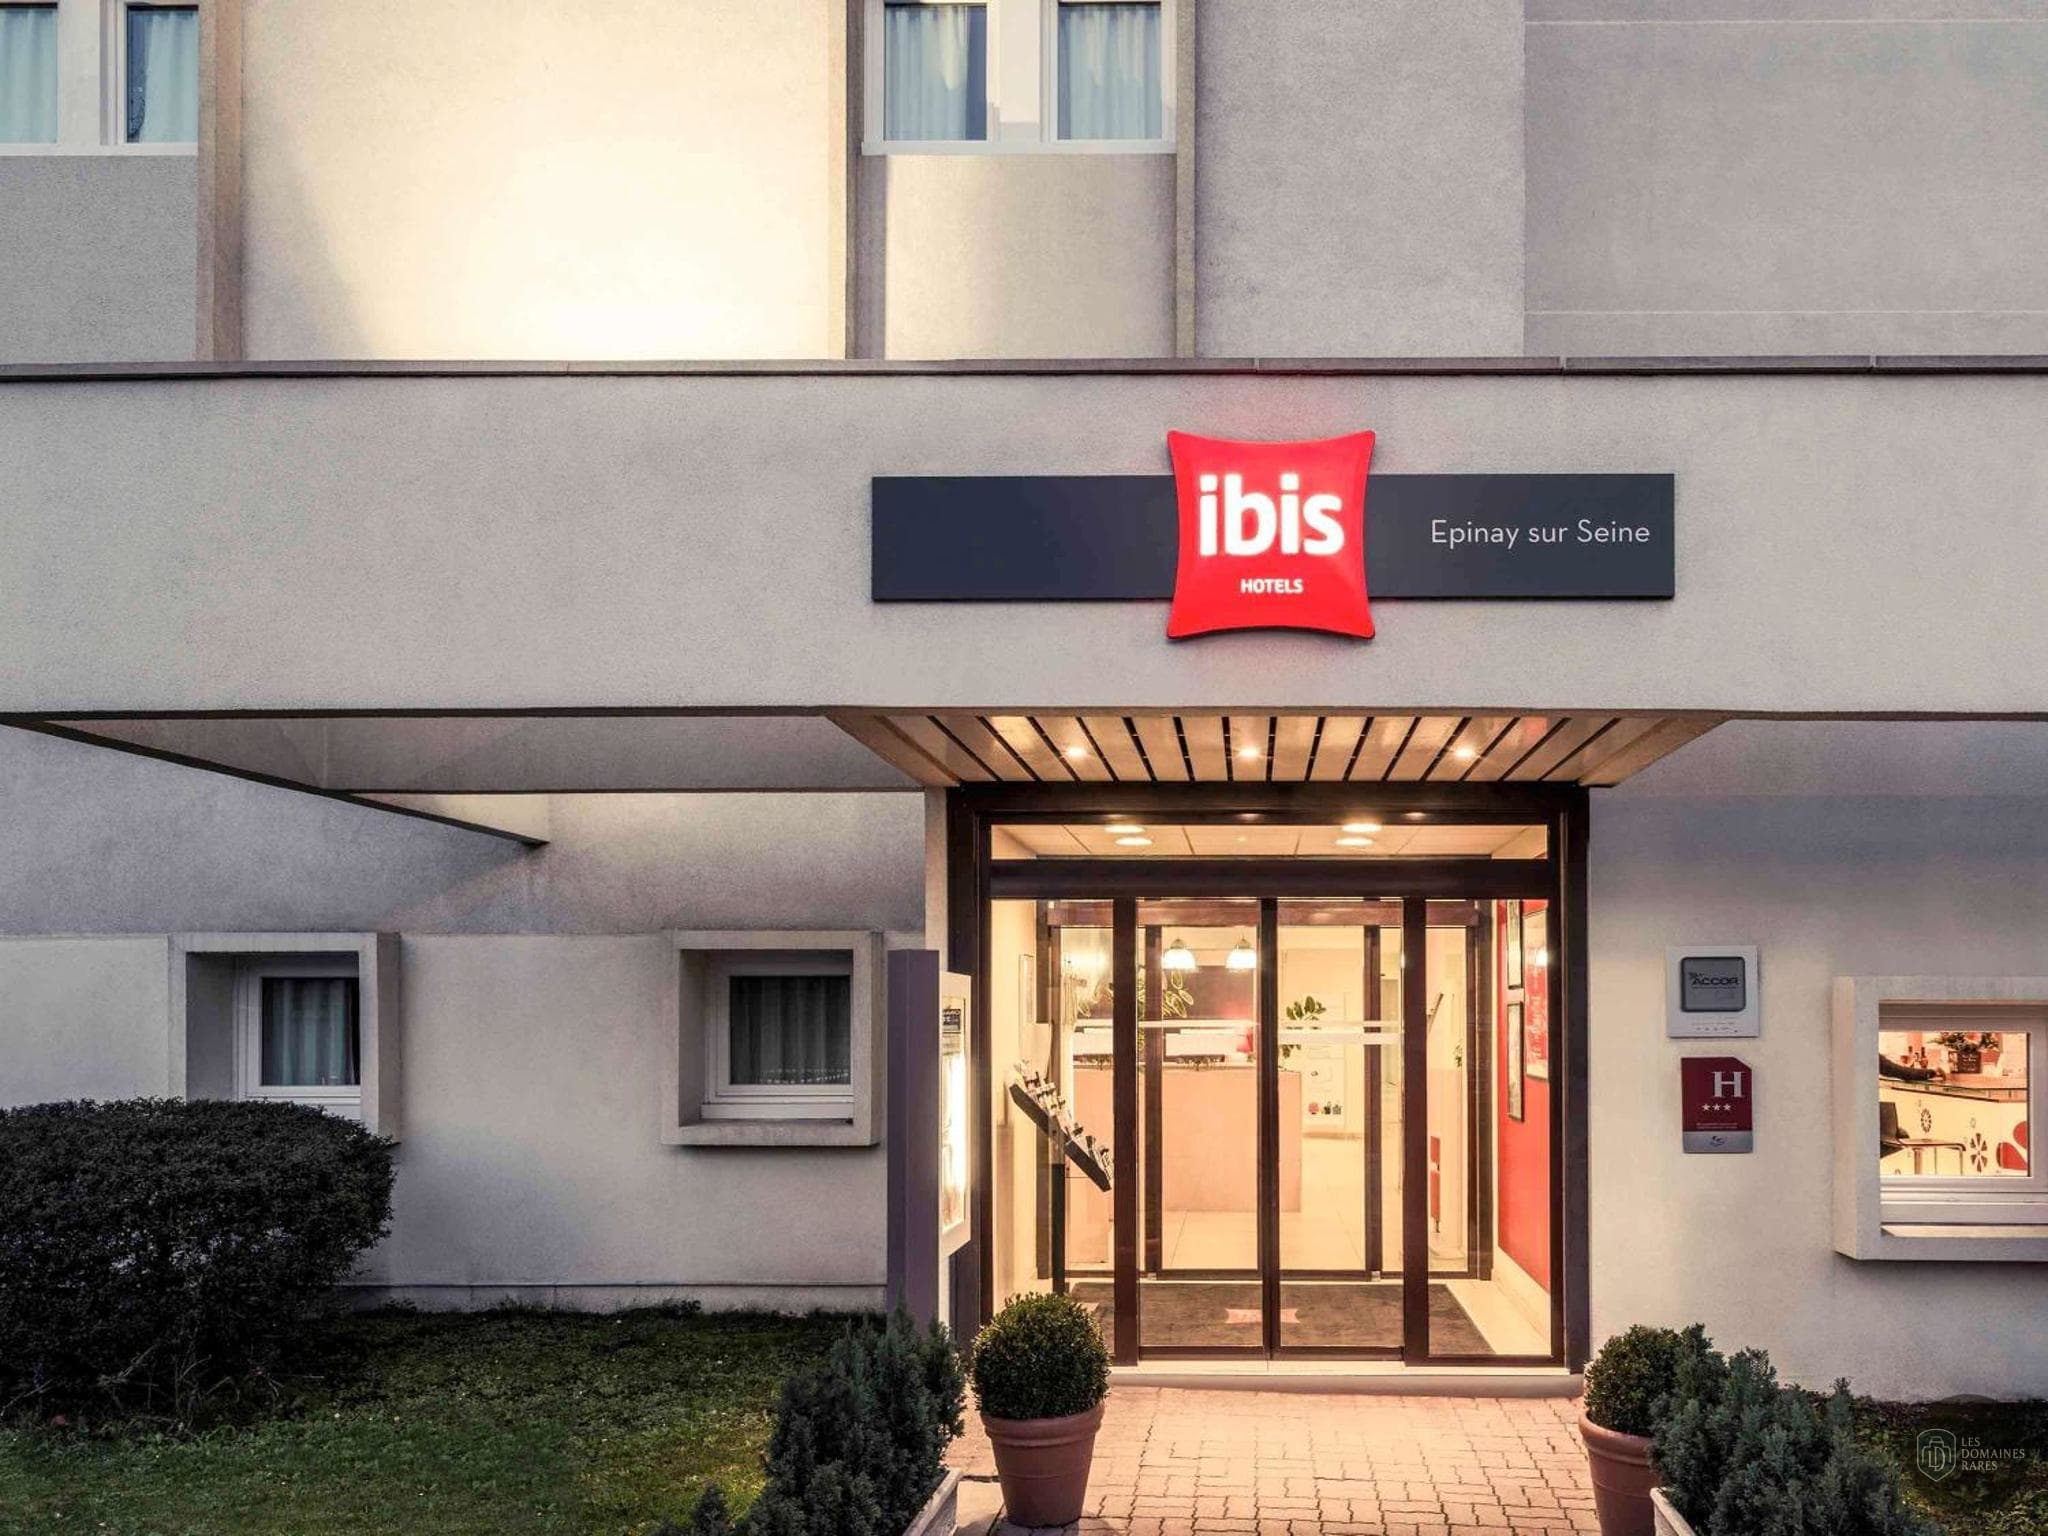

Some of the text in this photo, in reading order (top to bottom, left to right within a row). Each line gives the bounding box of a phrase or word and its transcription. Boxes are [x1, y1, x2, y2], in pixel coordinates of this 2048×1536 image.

[1199, 473, 1345, 556] ibis
[1431, 519, 1650, 550] Epinay sur Seine
[1240, 578, 1304, 594] HOTELS
[1691, 976, 1740, 986] ACCOR
[1712, 1071, 1745, 1098] H
